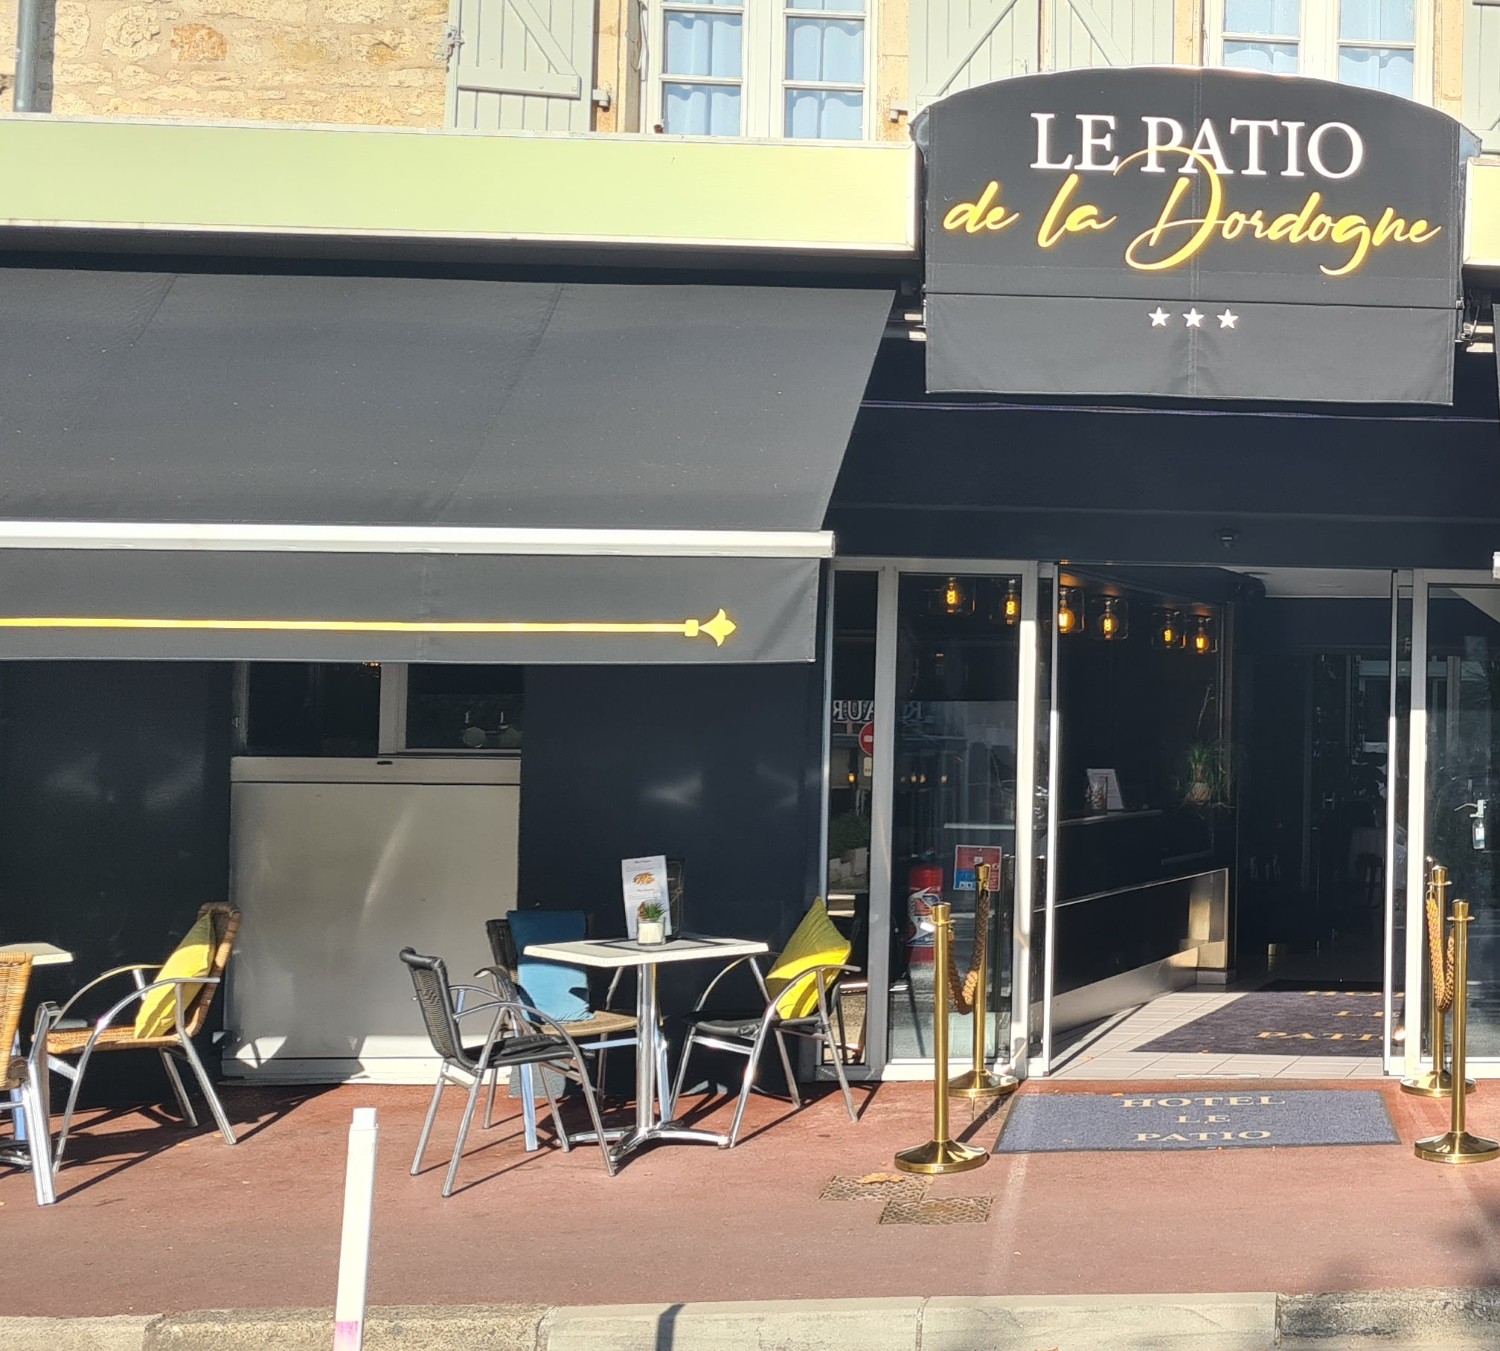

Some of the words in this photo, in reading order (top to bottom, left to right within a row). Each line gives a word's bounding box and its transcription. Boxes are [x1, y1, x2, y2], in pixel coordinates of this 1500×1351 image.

[1030, 112, 1120, 172] LE
[1140, 116, 1365, 179] PATIO
[942, 180, 1019, 234] de
[1037, 173, 1116, 248] la
[1113, 145, 1441, 276] Dordogne
[1122, 1094, 1285, 1108] HOTEL
[1177, 1113, 1231, 1124] LE
[1135, 1129, 1272, 1142] PATIO
